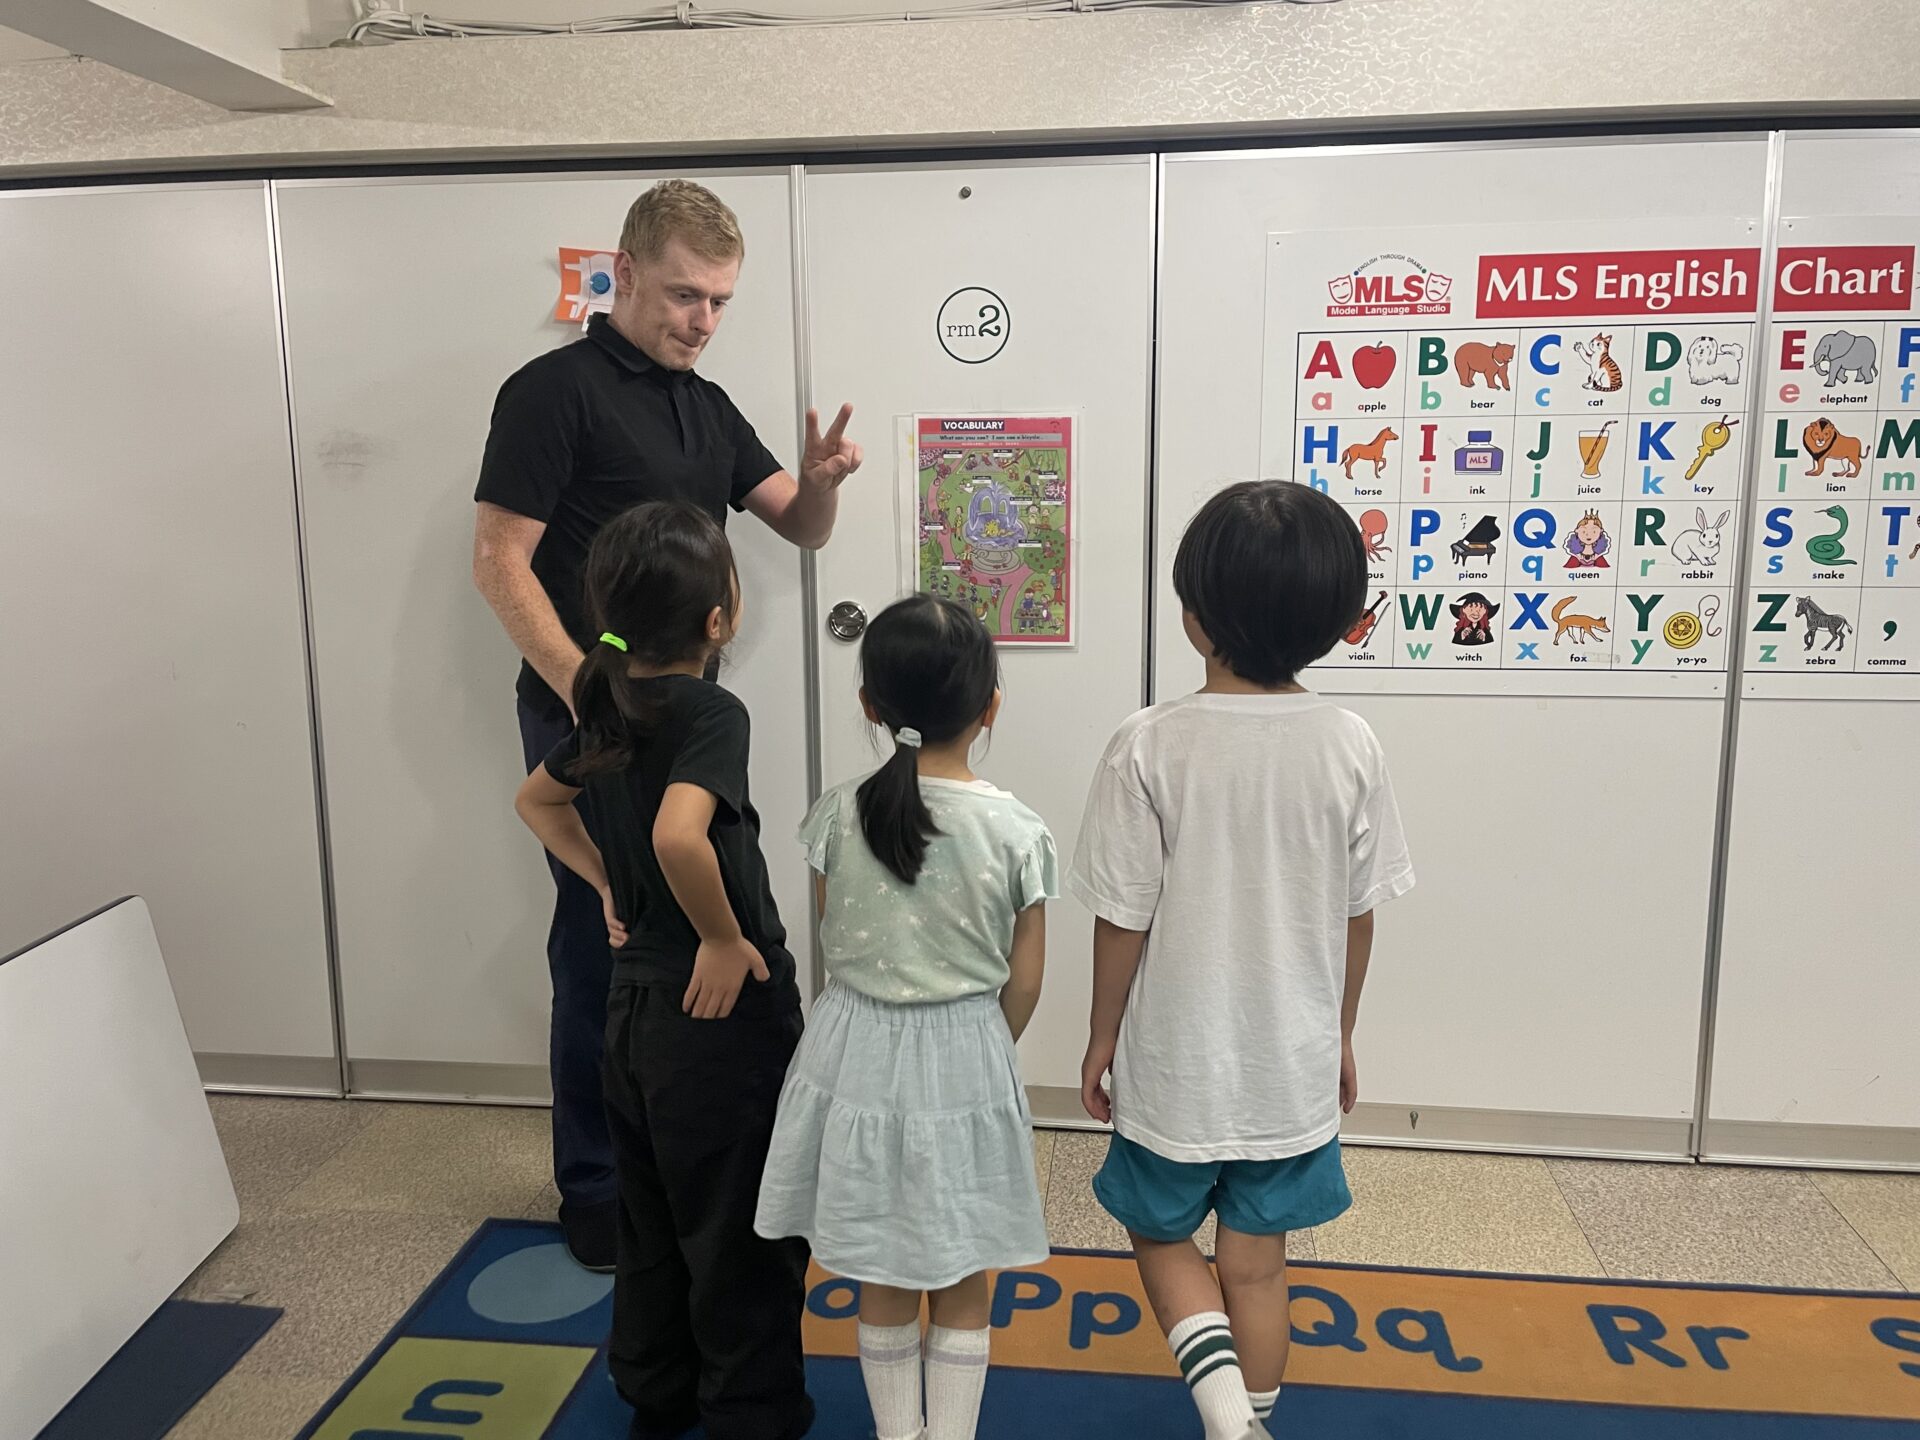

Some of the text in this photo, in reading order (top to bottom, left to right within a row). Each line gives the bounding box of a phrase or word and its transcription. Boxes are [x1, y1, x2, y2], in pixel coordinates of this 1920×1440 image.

[1354, 274, 1425, 303] MLS
[1485, 256, 1905, 310] MLS English Chart
[1331, 304, 1447, 316] Model Language Studio
[1304, 340, 1343, 379] A
[1418, 337, 1449, 376] B
[1529, 334, 1561, 375] C
[1645, 331, 1682, 371] D
[1780, 330, 1807, 370] E
[1898, 328, 1920, 368] F
[1420, 381, 1442, 410] b
[1535, 388, 1550, 407] c
[1648, 377, 1672, 406] d
[1779, 383, 1800, 403] e
[1820, 394, 1868, 405] elephant
[1900, 374, 1915, 403] f
[1312, 392, 1332, 411] a
[1357, 401, 1387, 412] apple
[1470, 400, 1495, 409] bear
[1587, 398, 1604, 407] cat
[1700, 396, 1722, 407] dog
[944, 421, 1004, 430] VOCABULARY
[1303, 426, 1338, 464] H
[1419, 424, 1438, 462] I
[1527, 422, 1551, 461] J
[1638, 421, 1676, 460] K
[1774, 419, 1798, 459] L
[1876, 419, 1920, 459] M
[1469, 455, 1488, 465] MLS
[1310, 469, 1328, 495] h
[1354, 486, 1382, 496] horse
[1423, 467, 1431, 494] i
[1469, 486, 1486, 495] ink
[1530, 463, 1541, 498] j
[1577, 484, 1601, 495] juice
[1642, 466, 1664, 495] k
[1694, 483, 1714, 495] key
[1826, 483, 1846, 492] lion
[1882, 471, 1915, 491] m
[1410, 509, 1441, 547] P
[1513, 508, 1557, 549] Q
[1634, 508, 1667, 547] R
[1763, 507, 1793, 548] S
[1882, 507, 1910, 546] T
[1412, 554, 1434, 580] p
[1458, 570, 1488, 581] piano
[1522, 555, 1543, 581] q
[1568, 571, 1600, 581] queen
[1640, 558, 1655, 577] r
[1681, 570, 1714, 579] rabbit
[1767, 554, 1783, 574] s
[1812, 570, 1845, 580] snake
[1885, 554, 1898, 577] t
[1399, 593, 1444, 630] W
[1509, 593, 1549, 630] X
[1626, 594, 1665, 632] Y
[1752, 594, 1791, 632] Z
[1348, 652, 1375, 661] violin
[1406, 643, 1433, 660] w
[1455, 652, 1483, 662] witch
[1515, 643, 1539, 660] x
[1570, 653, 1587, 663] fox
[1630, 639, 1654, 664] y
[1676, 656, 1707, 666] yo-yo
[1758, 645, 1778, 663] z
[1805, 656, 1836, 666] zebra
[1867, 657, 1906, 666] comma
